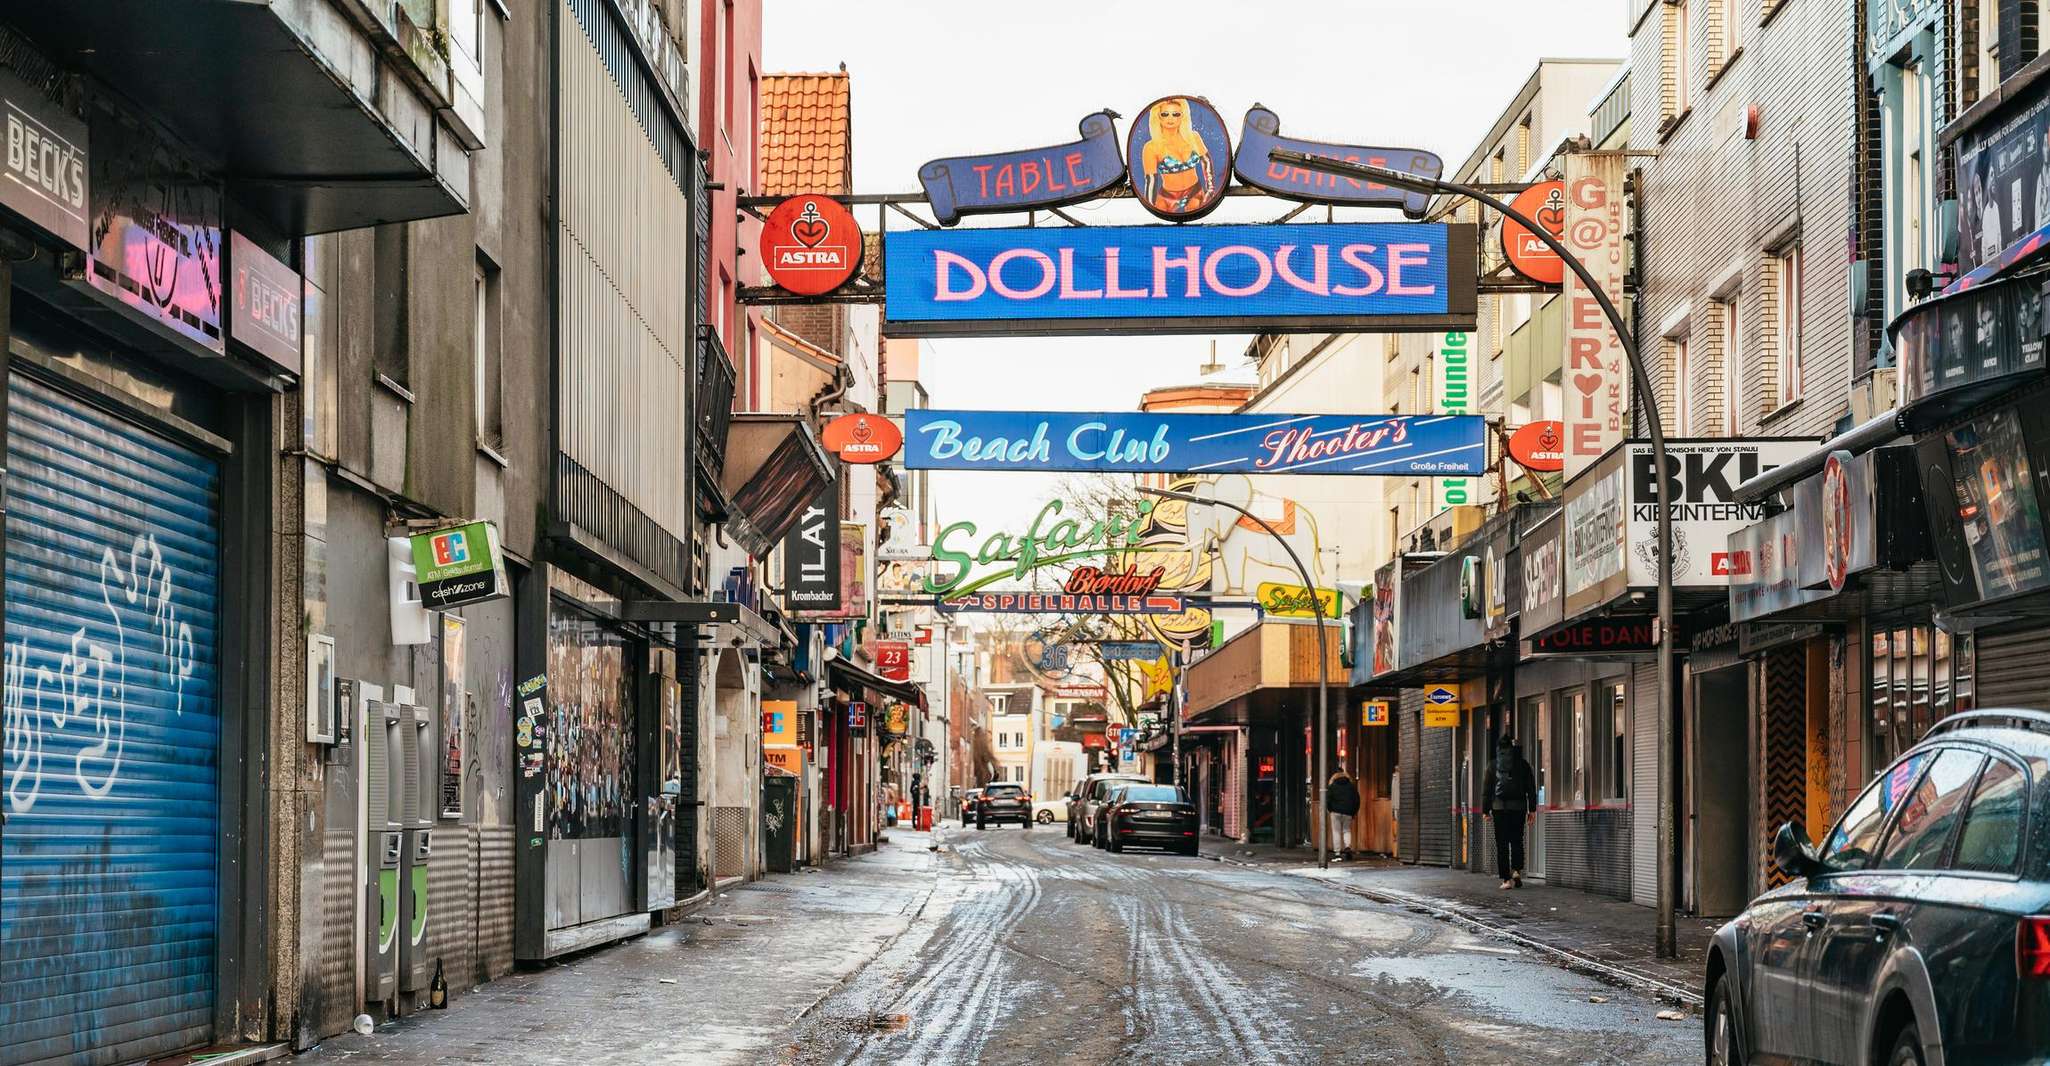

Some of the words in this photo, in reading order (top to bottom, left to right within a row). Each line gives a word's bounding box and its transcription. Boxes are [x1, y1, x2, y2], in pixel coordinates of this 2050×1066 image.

[8, 113, 83, 208] BECK'S
[972, 152, 1090, 198] TABLE
[1608, 201, 1621, 265] CLUB
[780, 251, 840, 264] ASTRA
[934, 243, 1435, 301] DOLLHOUSE
[1608, 383, 1621, 432] BAR
[844, 444, 880, 453] ASTRA
[918, 420, 1049, 463] Beach
[1067, 422, 1170, 464] Club
[1255, 418, 1408, 469] Shooter's
[1410, 462, 1437, 473] Große
[1438, 462, 1469, 473] Freiheit
[801, 504, 826, 583] ILAY
[924, 499, 1154, 594] Safari
[791, 588, 834, 601] Krombacher
[983, 593, 1141, 611] SPIELHALLE
[1064, 563, 1166, 600] Bierdorf
[885, 652, 901, 664] 23
[1042, 645, 1069, 671] 36
